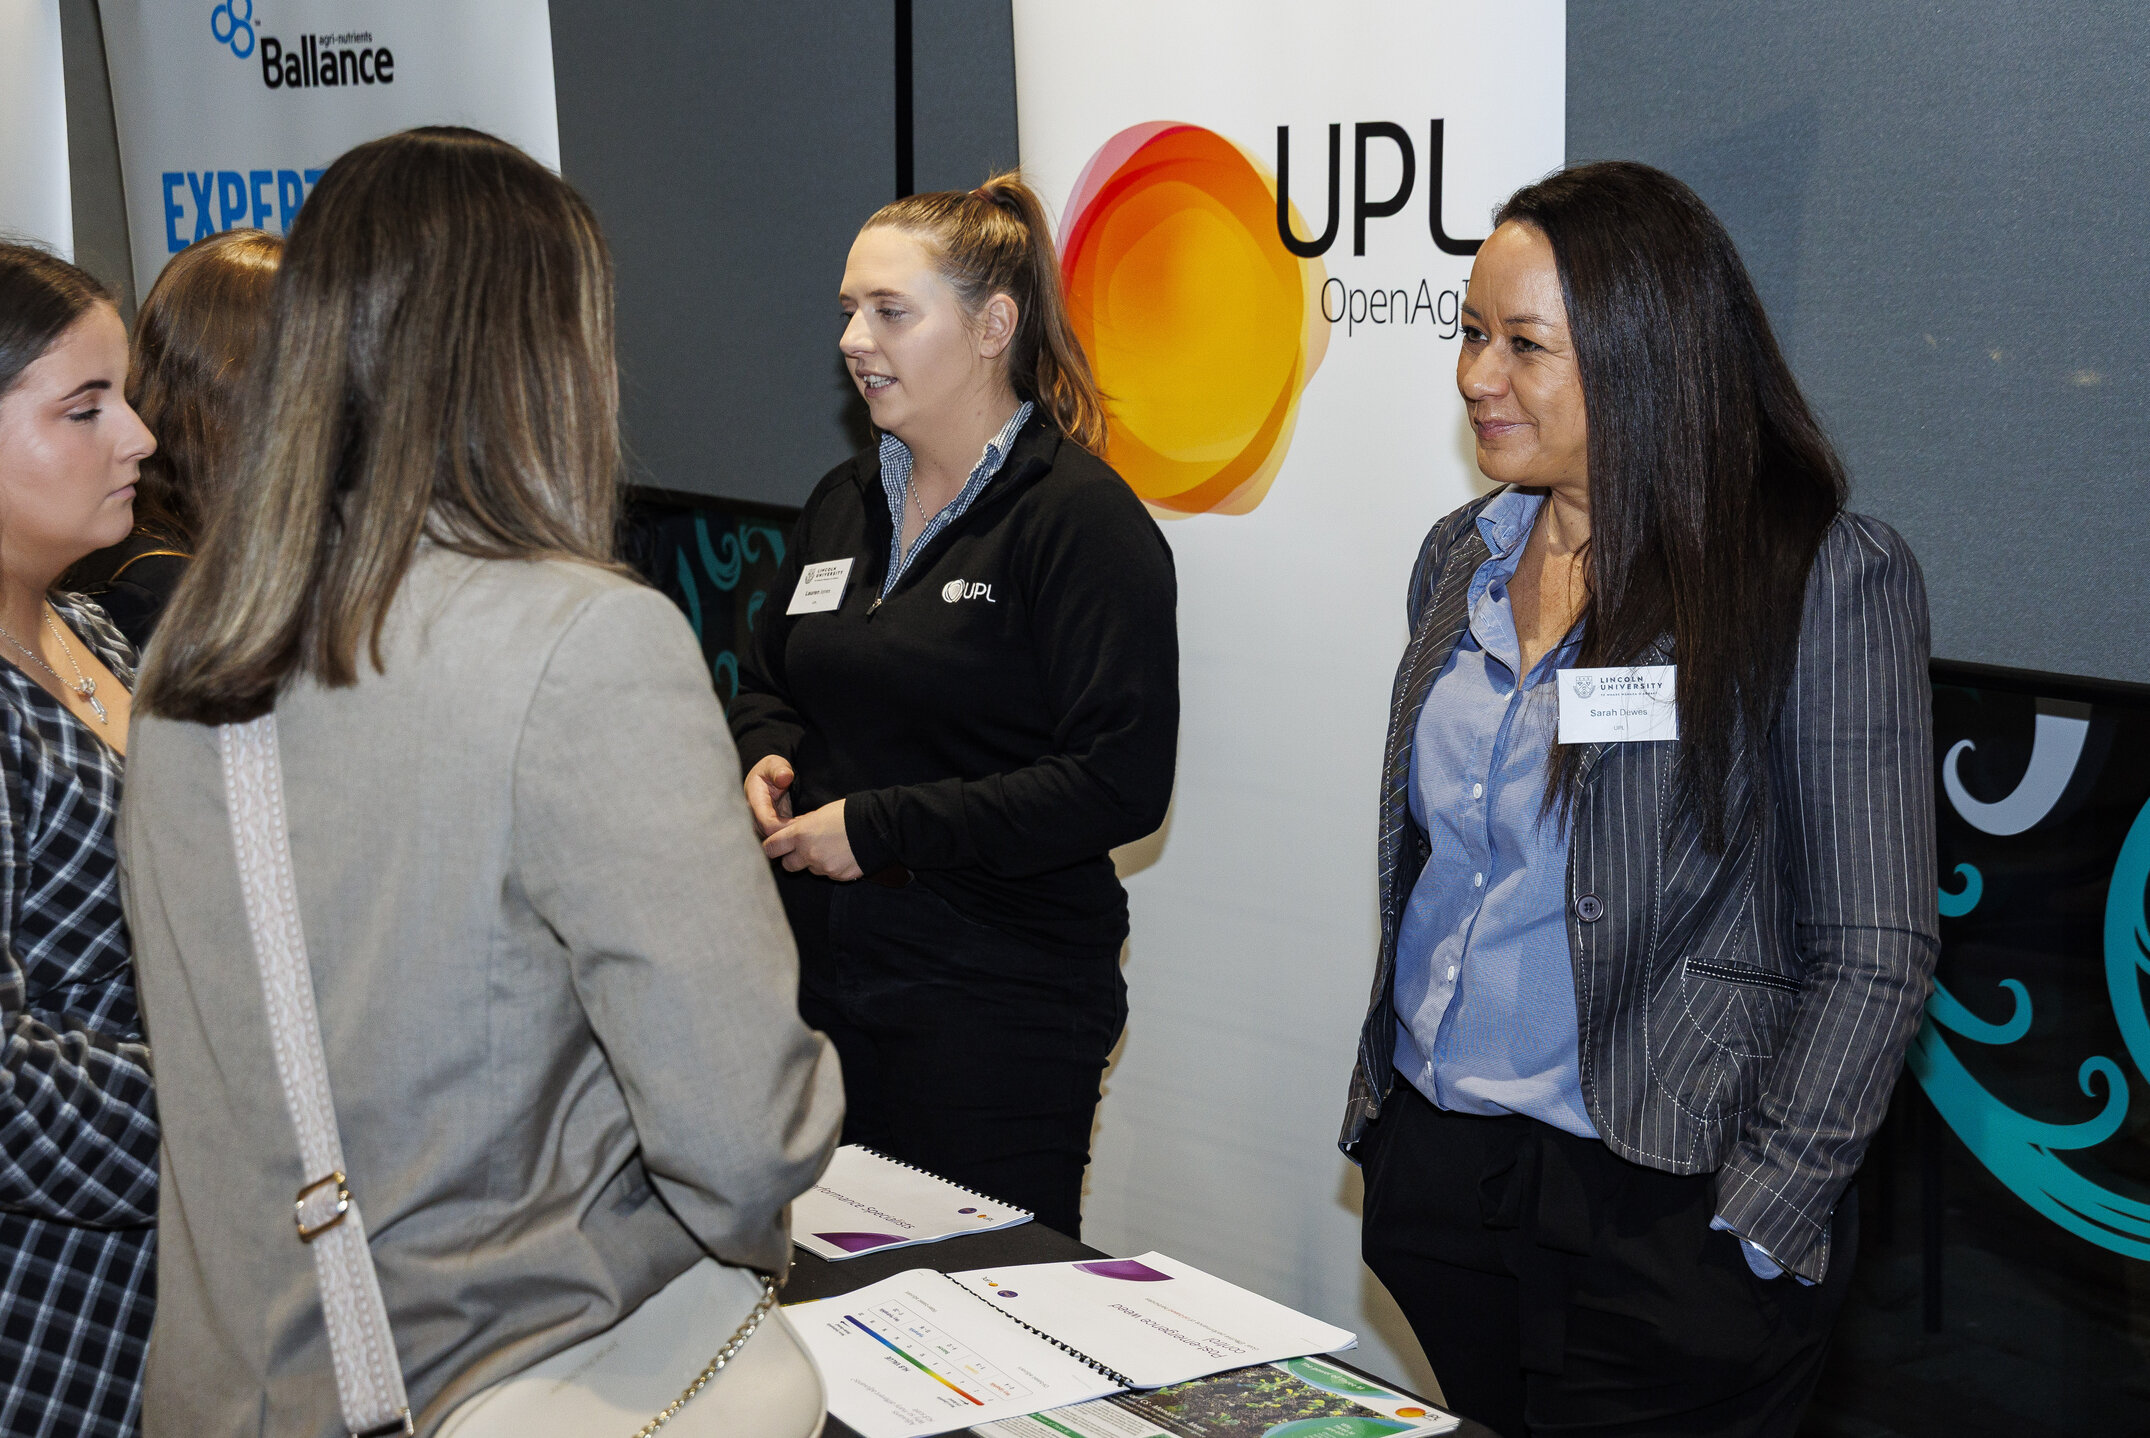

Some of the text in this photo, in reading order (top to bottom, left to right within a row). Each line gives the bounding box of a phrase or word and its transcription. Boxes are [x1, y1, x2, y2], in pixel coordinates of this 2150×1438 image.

[319, 30, 373, 48] agri-nutrients
[260, 34, 394, 90] Ballance
[1276, 118, 1487, 258] UPL
[963, 582, 996, 603] UPL
[1600, 676, 1644, 684] LINCOLN
[1600, 682, 1663, 691] UNIVERSITY
[1590, 708, 1648, 718] Sarah Dewes
[812, 1184, 865, 1213] erformance
[1108, 1303, 1142, 1319] weed
[1140, 1317, 1229, 1359] Post-emergence
[1202, 1337, 1247, 1354] control
